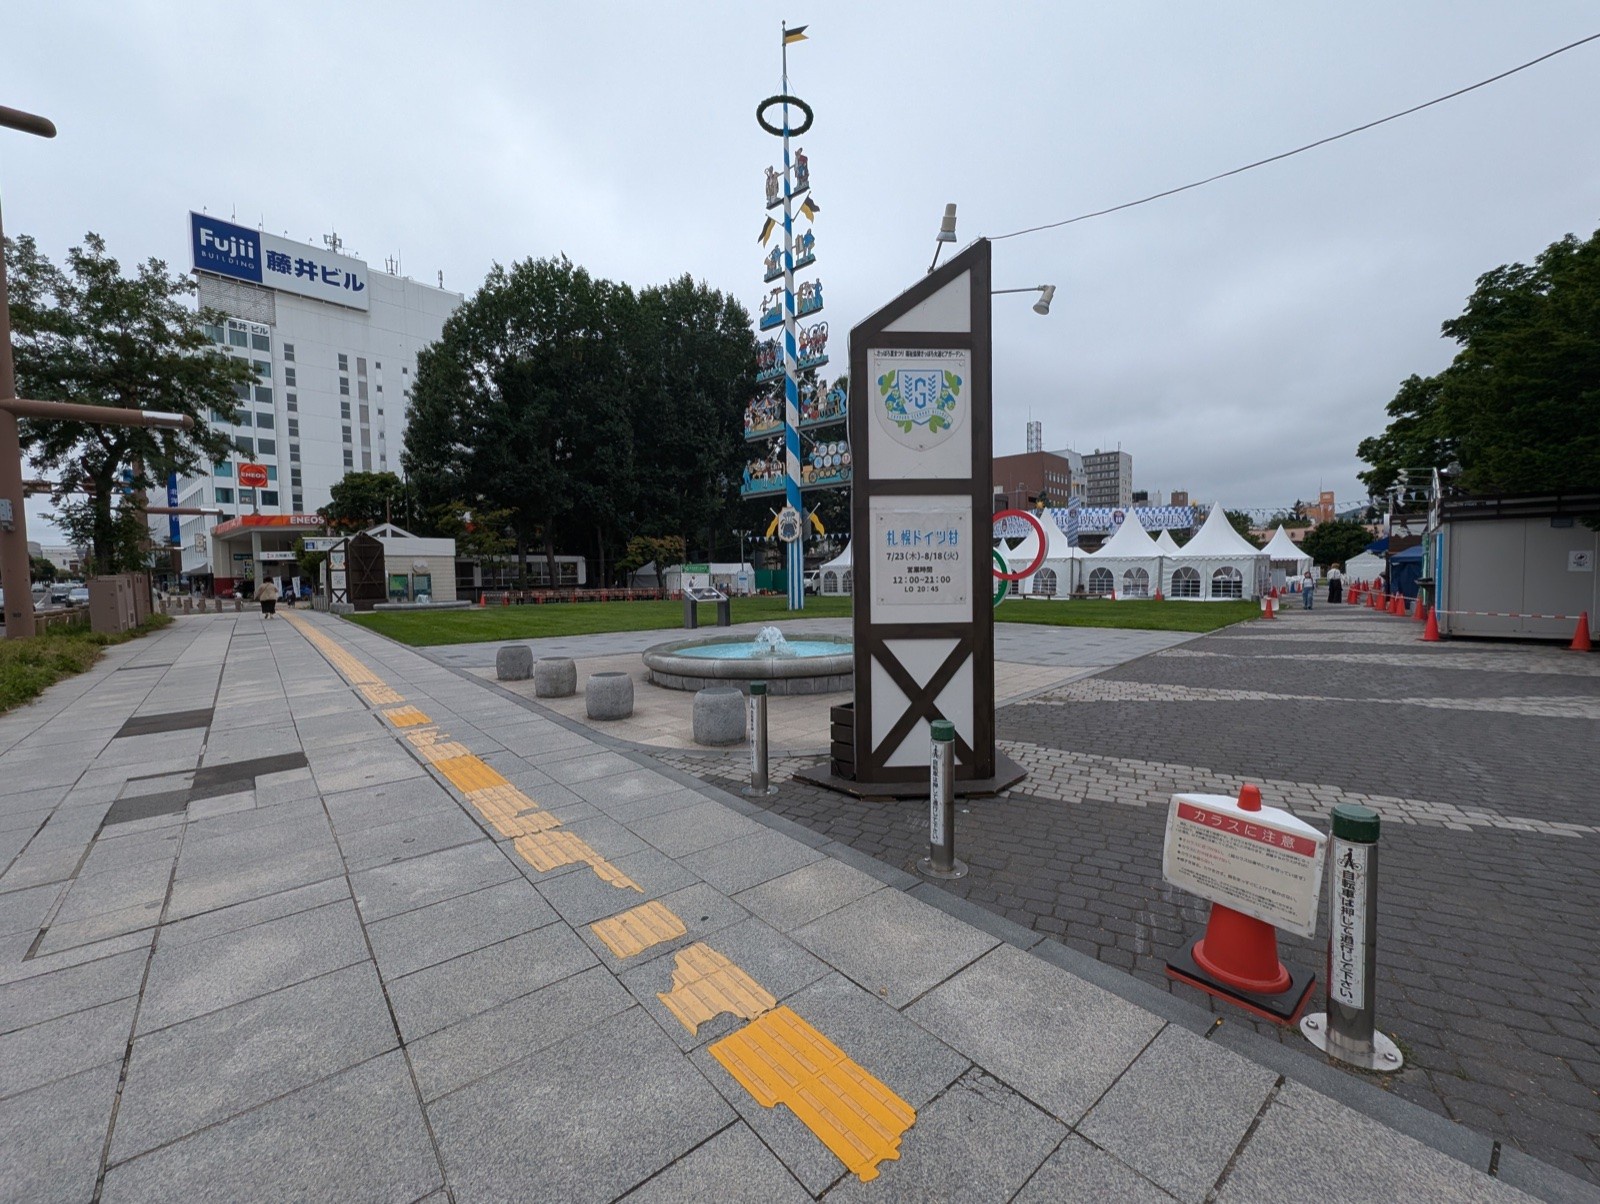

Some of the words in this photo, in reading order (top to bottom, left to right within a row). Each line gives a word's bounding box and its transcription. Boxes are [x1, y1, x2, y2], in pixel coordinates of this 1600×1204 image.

[199, 227, 254, 260] Fujii
[201, 250, 255, 270] BUILDING
[265, 249, 365, 292] 藤井ビル
[228, 320, 269, 335] 藤井ビル
[240, 471, 266, 480] ENEOS
[289, 516, 326, 525] ENEOS
[886, 529, 959, 546] 札幌ドイツ村
[906, 566, 933, 574] 営業時間
[1193, 810, 1295, 849] カラスに注意
[1339, 869, 1356, 1004] 自転車は押して通行して下さい。
